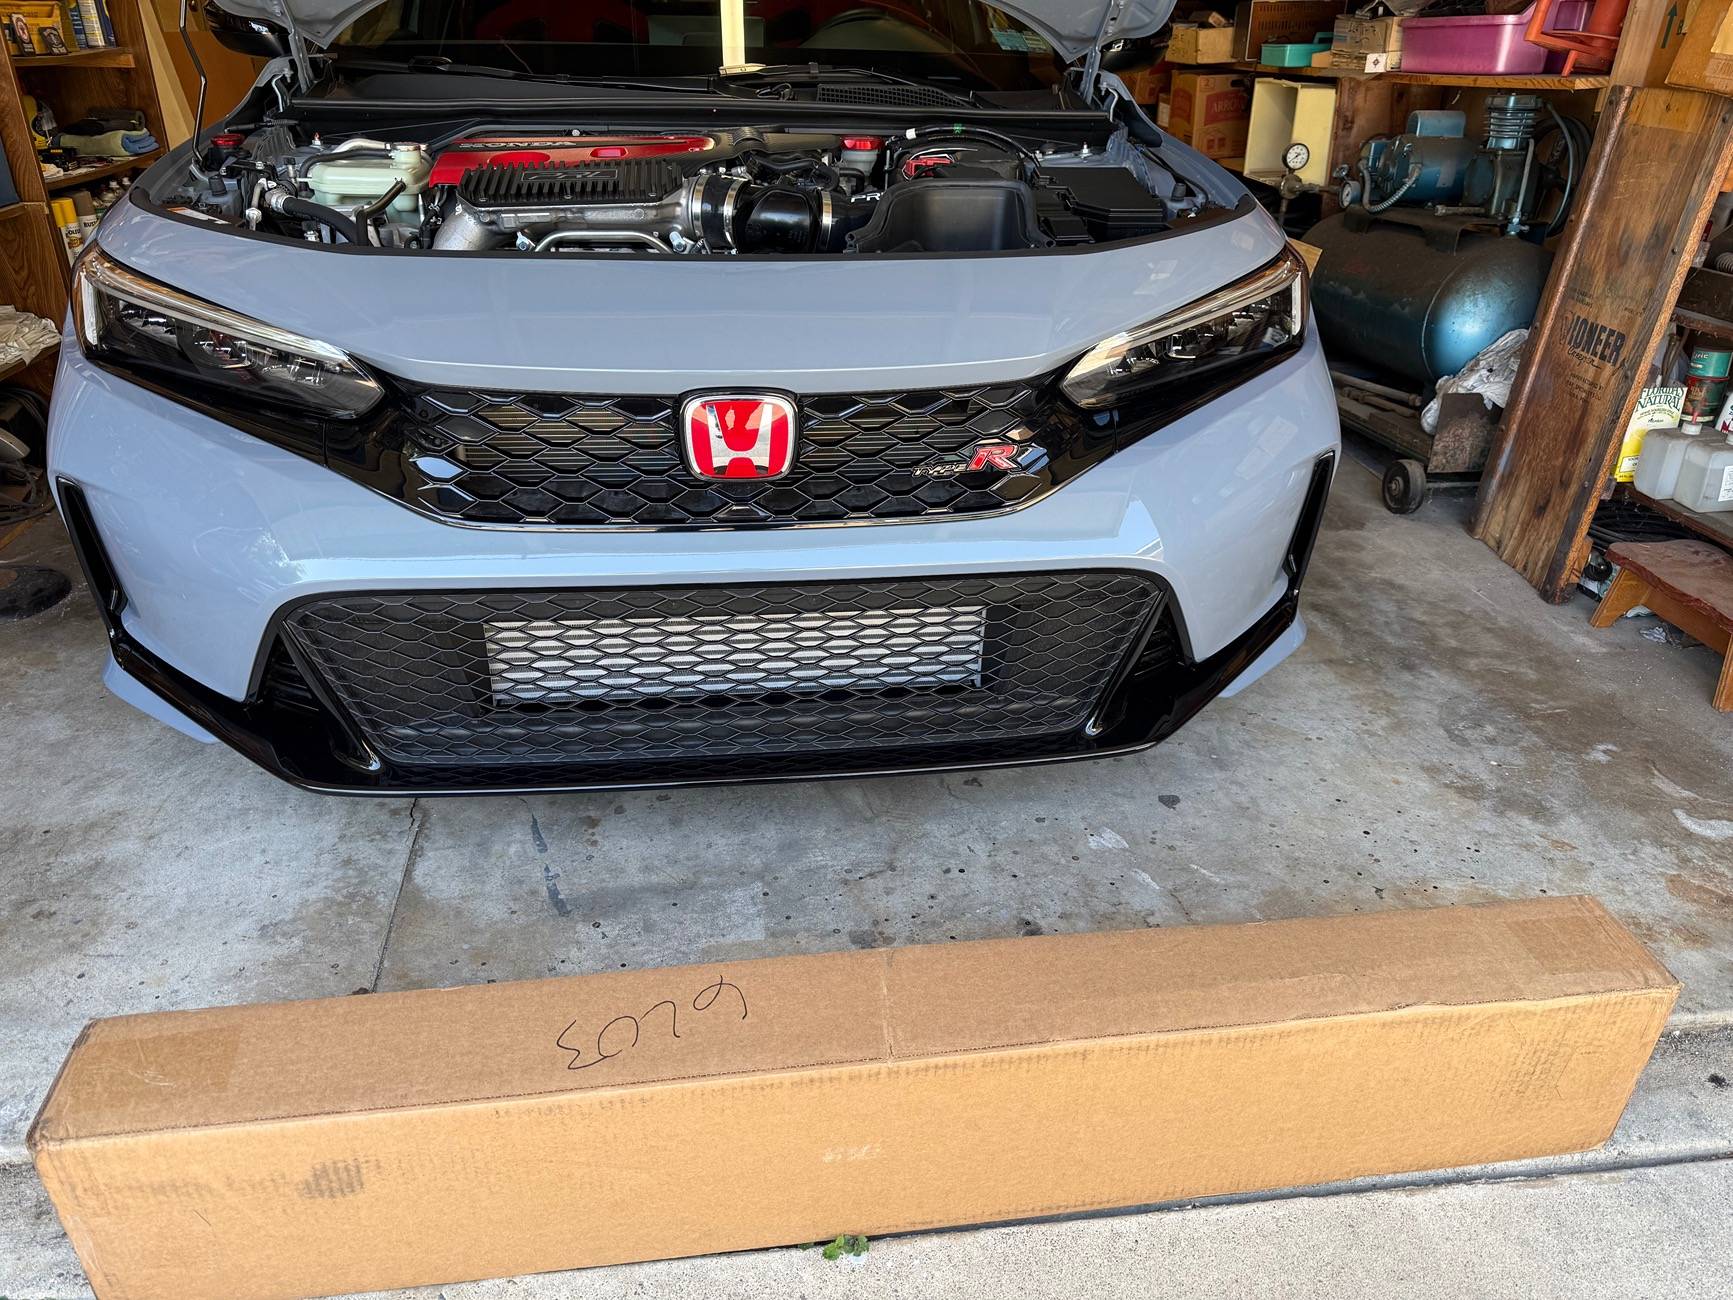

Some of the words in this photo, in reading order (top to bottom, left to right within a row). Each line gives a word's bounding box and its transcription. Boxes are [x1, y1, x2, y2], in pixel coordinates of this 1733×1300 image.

[459, 141, 577, 149] HONDA
[851, 193, 884, 203] PR
[1636, 395, 1681, 412] NATURAL
[967, 444, 1022, 472] R
